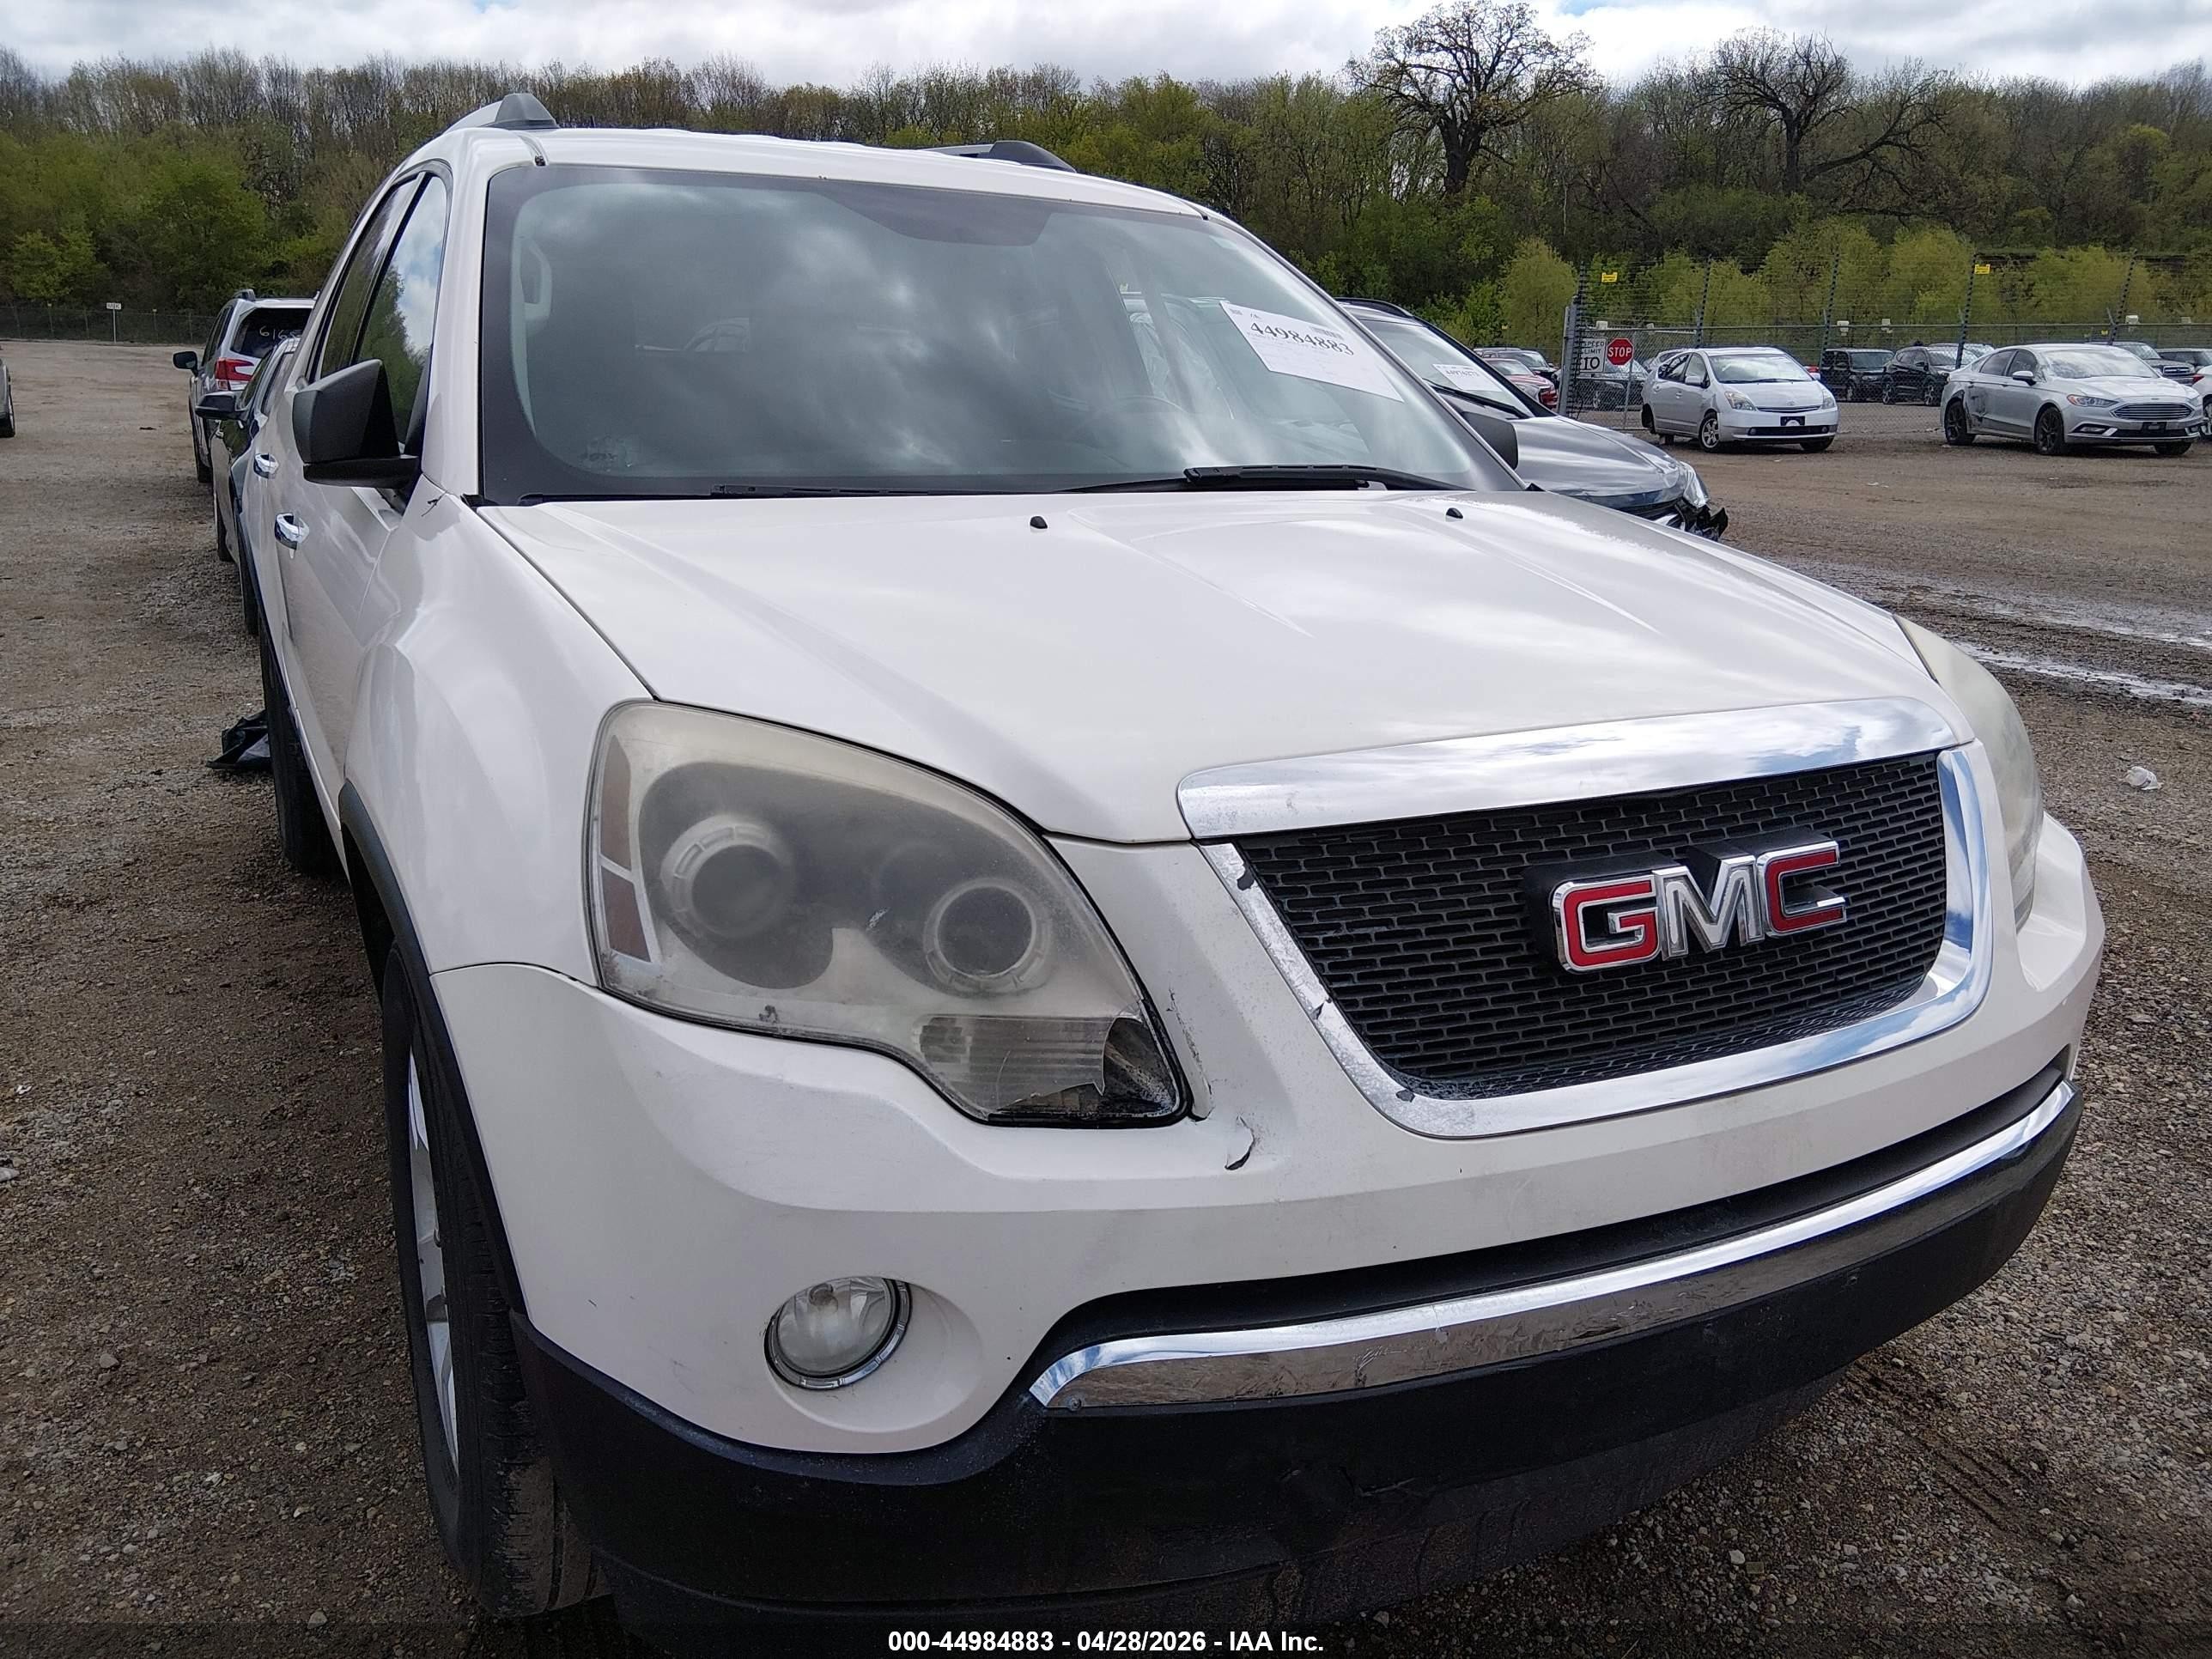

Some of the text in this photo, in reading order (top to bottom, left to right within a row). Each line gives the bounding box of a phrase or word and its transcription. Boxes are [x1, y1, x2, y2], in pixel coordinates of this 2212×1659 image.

[1250, 322, 1354, 356] 44984883
[1583, 356, 1601, 370] 10
[1608, 347, 1632, 357] STOP
[1553, 840, 1847, 973] GMC
